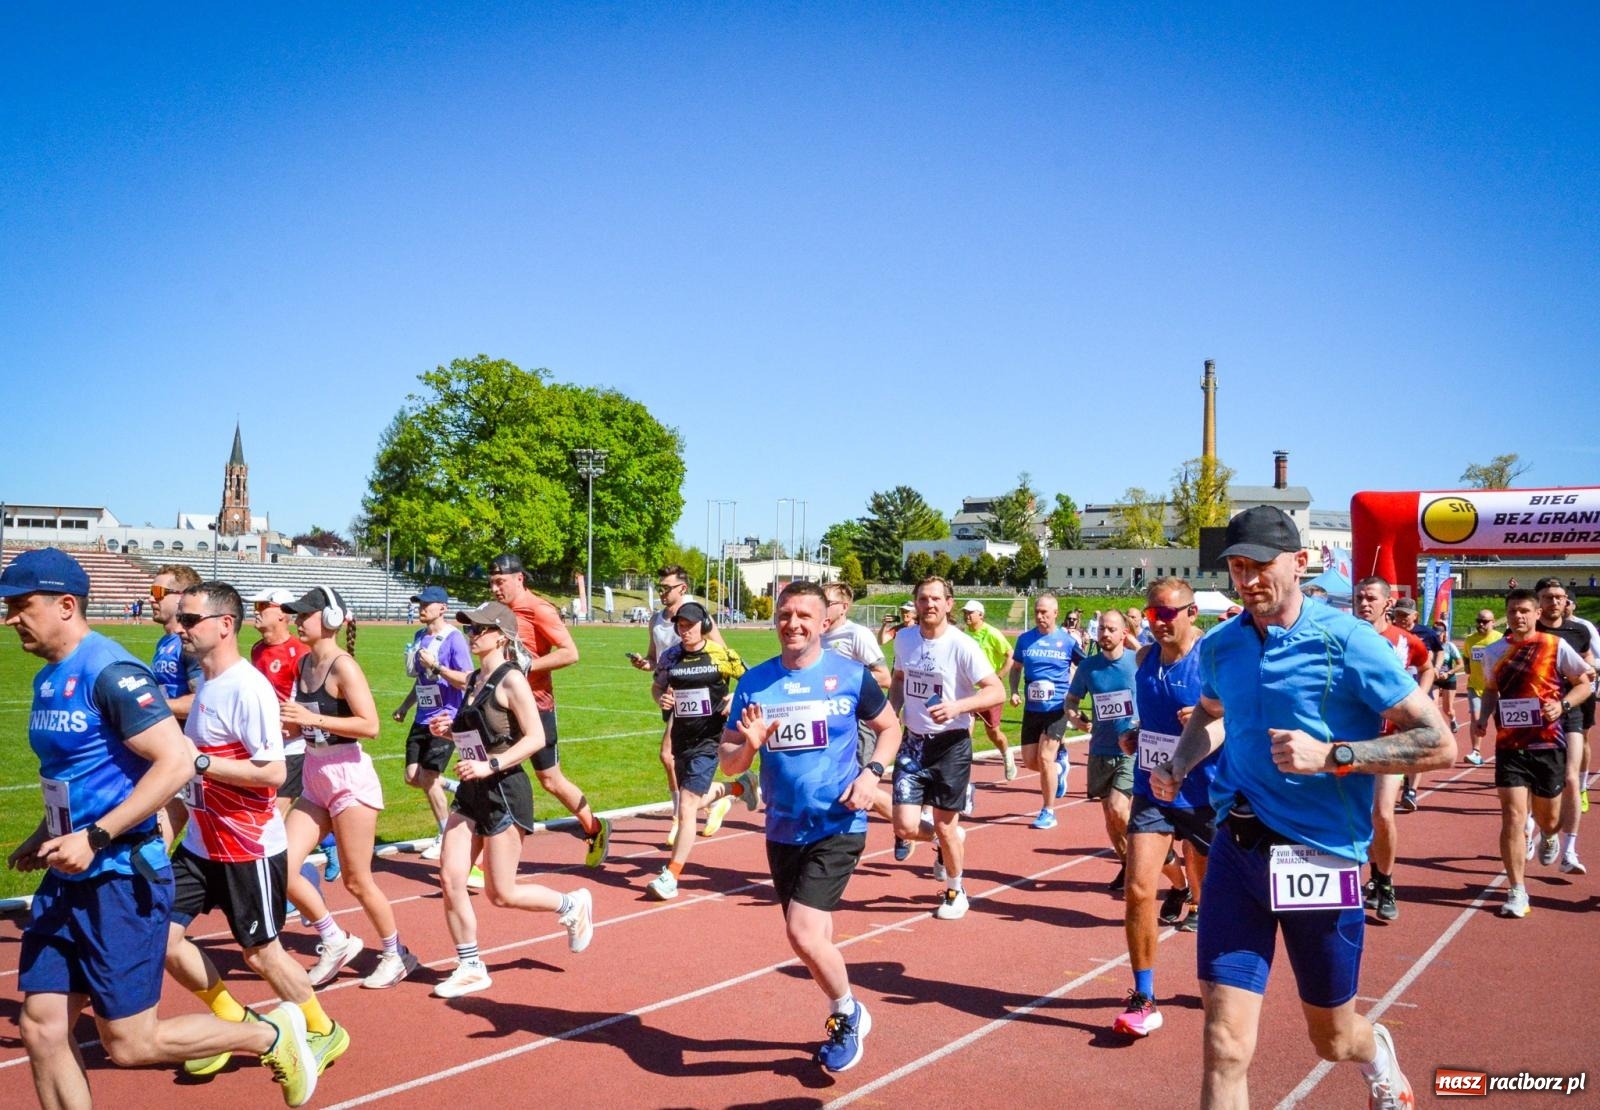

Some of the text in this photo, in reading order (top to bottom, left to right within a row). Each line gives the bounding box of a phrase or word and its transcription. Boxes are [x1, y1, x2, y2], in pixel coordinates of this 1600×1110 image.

[1529, 494, 1579, 505] BIEG
[1493, 512, 1535, 525] BEZ
[1503, 528, 1600, 543] RACIBÓRZ
[913, 681, 928, 694] 117
[1031, 690, 1045, 699] 213
[680, 701, 698, 712] 212
[1100, 703, 1122, 715] 220
[1506, 711, 1528, 722] 229
[775, 723, 806, 743] 146
[1145, 749, 1169, 766] 143
[1286, 873, 1330, 898] 107
